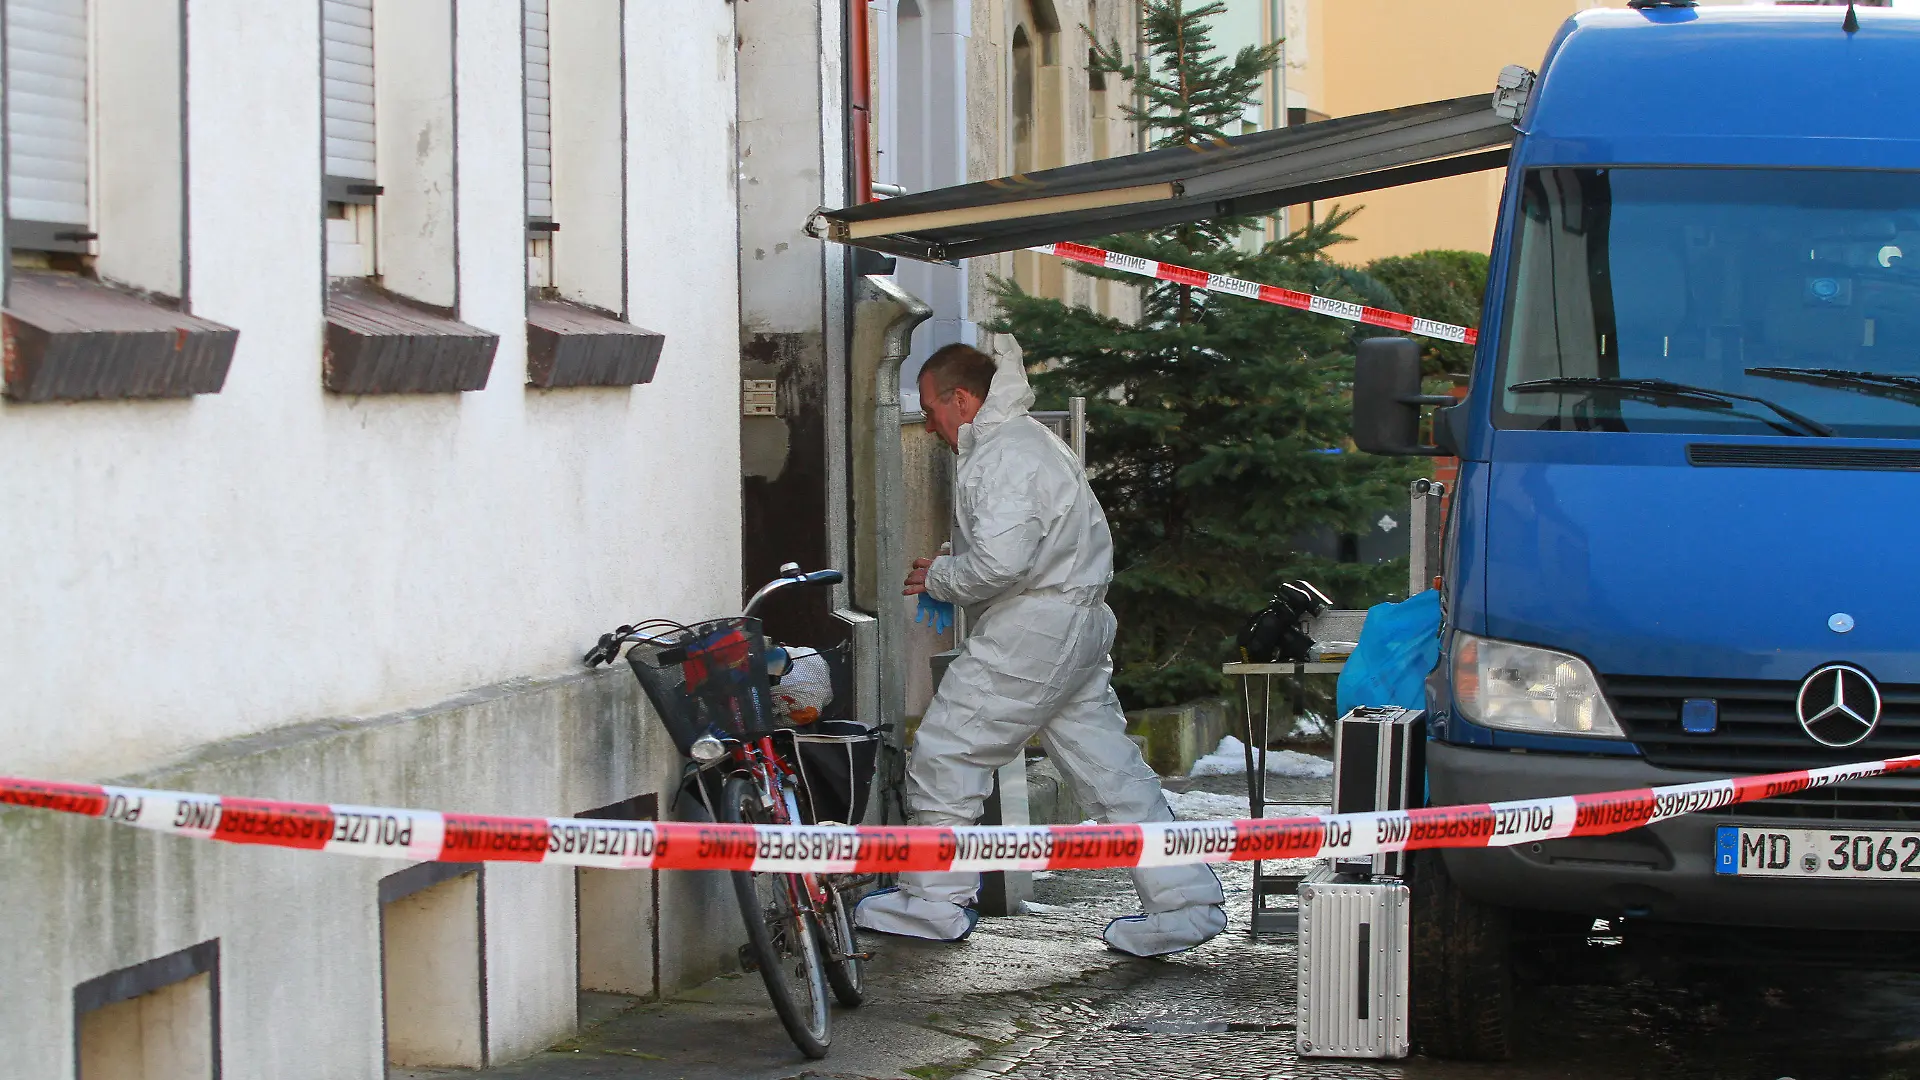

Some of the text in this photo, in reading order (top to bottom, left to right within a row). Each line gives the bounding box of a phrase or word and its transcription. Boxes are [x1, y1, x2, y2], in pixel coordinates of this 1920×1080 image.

[173, 801, 412, 847] POLIZEIABSPERRUNG
[445, 821, 668, 857] POLIZEIABSPERRUNG
[1164, 822, 1351, 855] POLIZEIABSPERRUNG
[1376, 805, 1553, 843] POLIZEIABSPERRUNG
[699, 830, 909, 862] POLIZEIABSPERRUNG
[938, 830, 1138, 862] POLIZEIABSPERRUNG
[1723, 854, 1732, 865] D
[1741, 832, 1920, 873] MD 3062
